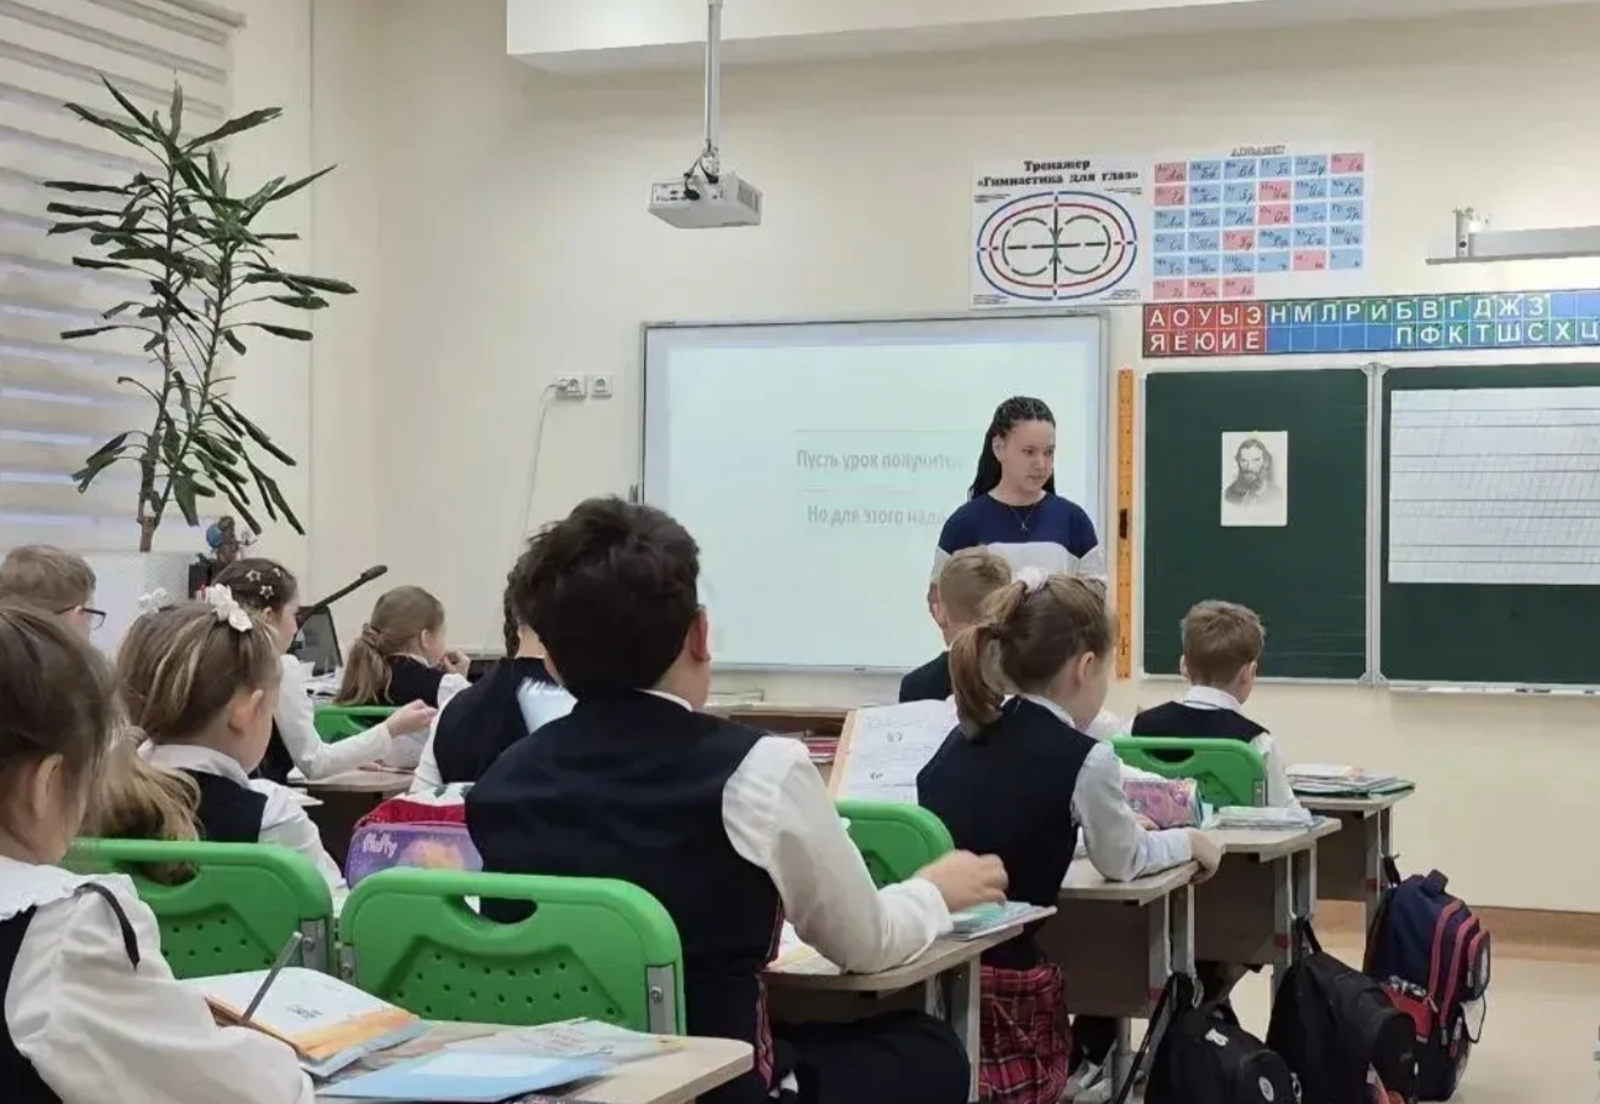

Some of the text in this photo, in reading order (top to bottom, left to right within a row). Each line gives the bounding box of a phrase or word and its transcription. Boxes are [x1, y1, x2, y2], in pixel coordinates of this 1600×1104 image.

[1024, 160, 1090, 172] Тренажер
[978, 172, 1138, 187] «Гимнастика для глаз»
[1150, 310, 1165, 326] А
[1173, 309, 1189, 326] О
[1200, 308, 1212, 324] У
[1220, 307, 1238, 324] Ы
[1246, 306, 1261, 323] Э
[1272, 306, 1286, 322] Н
[1295, 306, 1311, 322] М
[1321, 305, 1336, 322] Л
[1347, 304, 1360, 321] Р
[1397, 301, 1412, 320] Б
[1422, 301, 1437, 318] В
[1451, 300, 1462, 317] Г
[1474, 299, 1490, 318] Д
[1500, 297, 1520, 316] Ж
[1530, 297, 1542, 316] З
[1150, 335, 1165, 351] Я
[1195, 333, 1215, 350] Ю
[1222, 333, 1236, 349] И
[1246, 332, 1260, 348] Е
[1397, 327, 1412, 344] П
[1421, 326, 1439, 343] Ф
[1450, 326, 1462, 343] К
[1476, 324, 1489, 342] Т
[1498, 324, 1520, 342] Ш
[1528, 324, 1542, 341] С
[1556, 323, 1570, 340] Х
[797, 450, 838, 471] Пусть
[842, 454, 878, 473] урок
[808, 504, 828, 522] Но
[830, 508, 859, 527] для
[863, 509, 904, 524] этого
